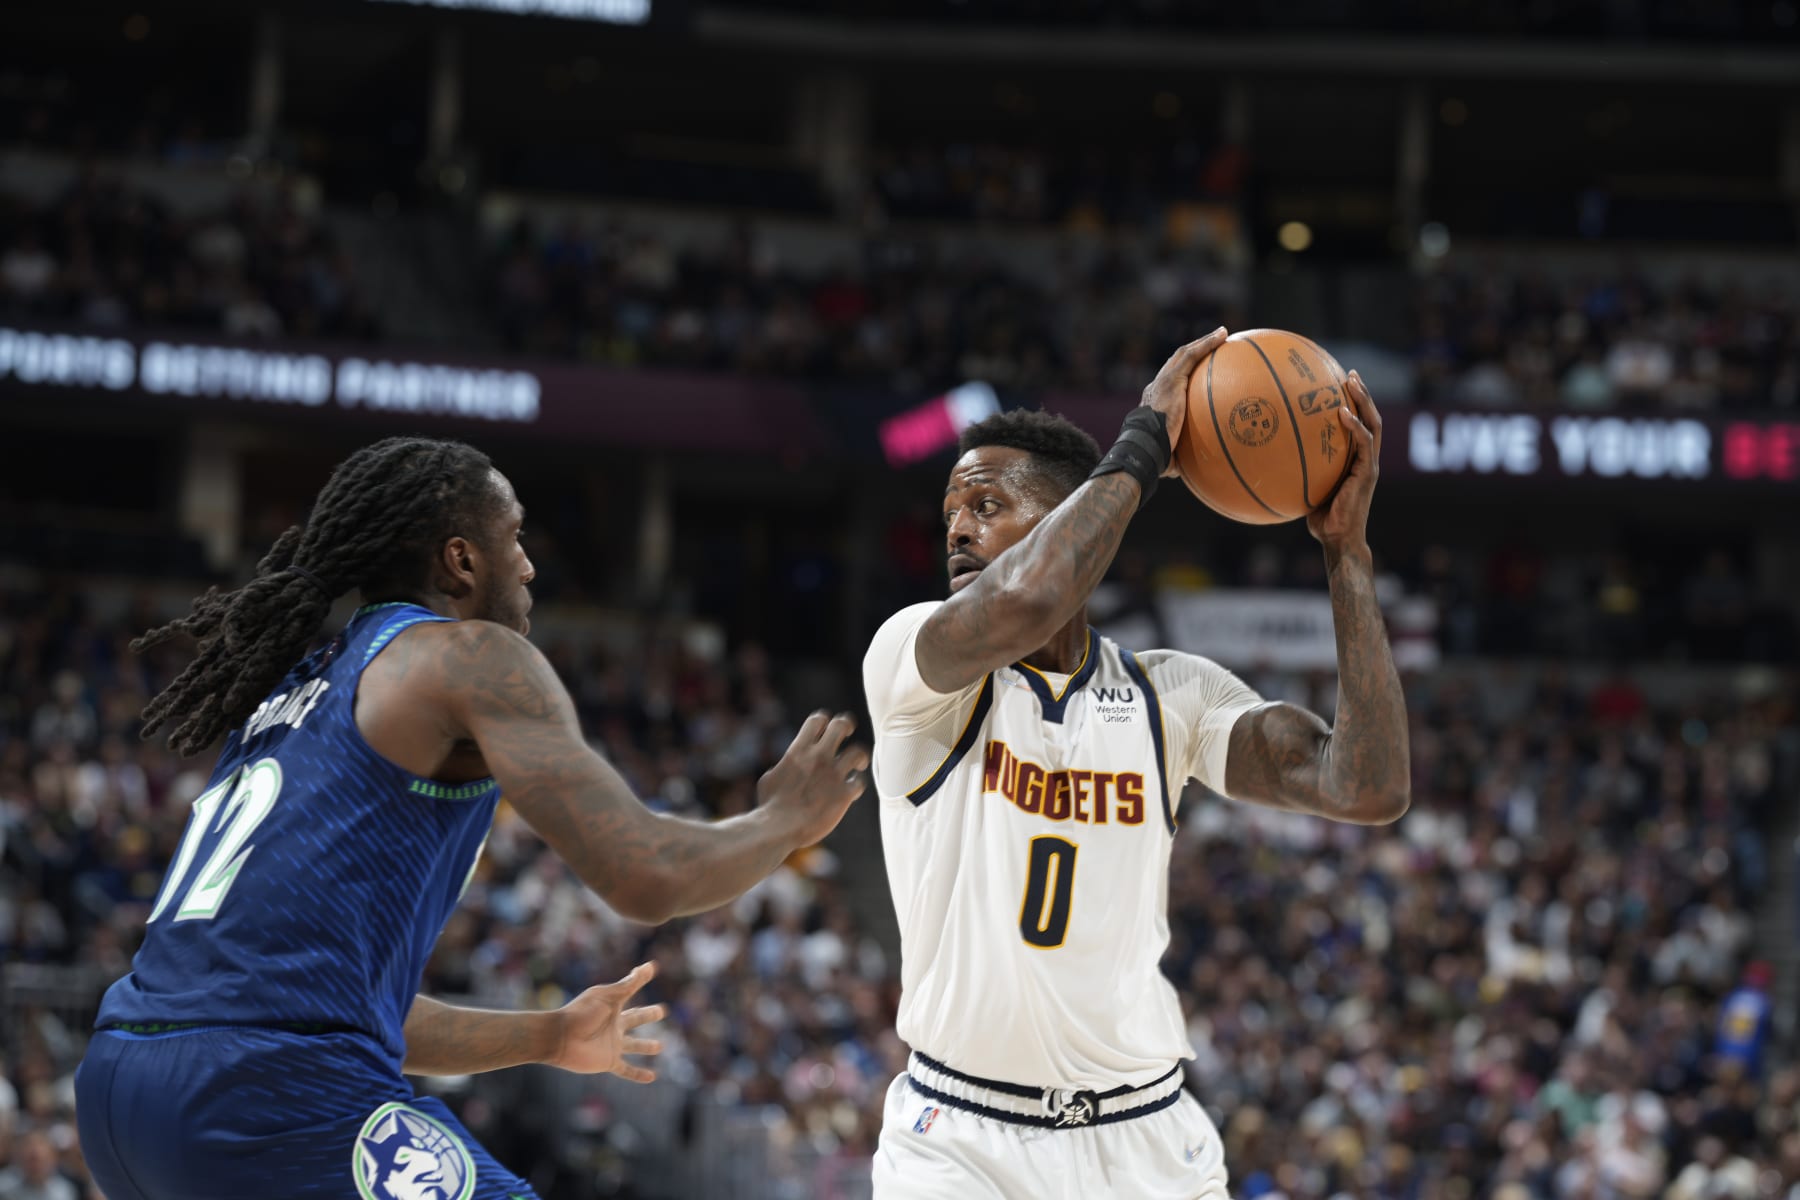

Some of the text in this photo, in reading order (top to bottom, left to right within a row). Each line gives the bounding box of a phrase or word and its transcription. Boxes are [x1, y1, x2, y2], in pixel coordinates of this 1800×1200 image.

[139, 342, 332, 406] BETTING
[335, 357, 541, 423] PARTNER
[1408, 411, 1542, 474] LIVE
[1550, 416, 1711, 478] YOUR
[1091, 687, 1134, 703] WU
[1095, 705, 1137, 715] Western
[1103, 713, 1132, 723] Union
[982, 739, 1145, 826] NUGGETS
[146, 757, 283, 924] 12
[1018, 834, 1079, 951] 0
